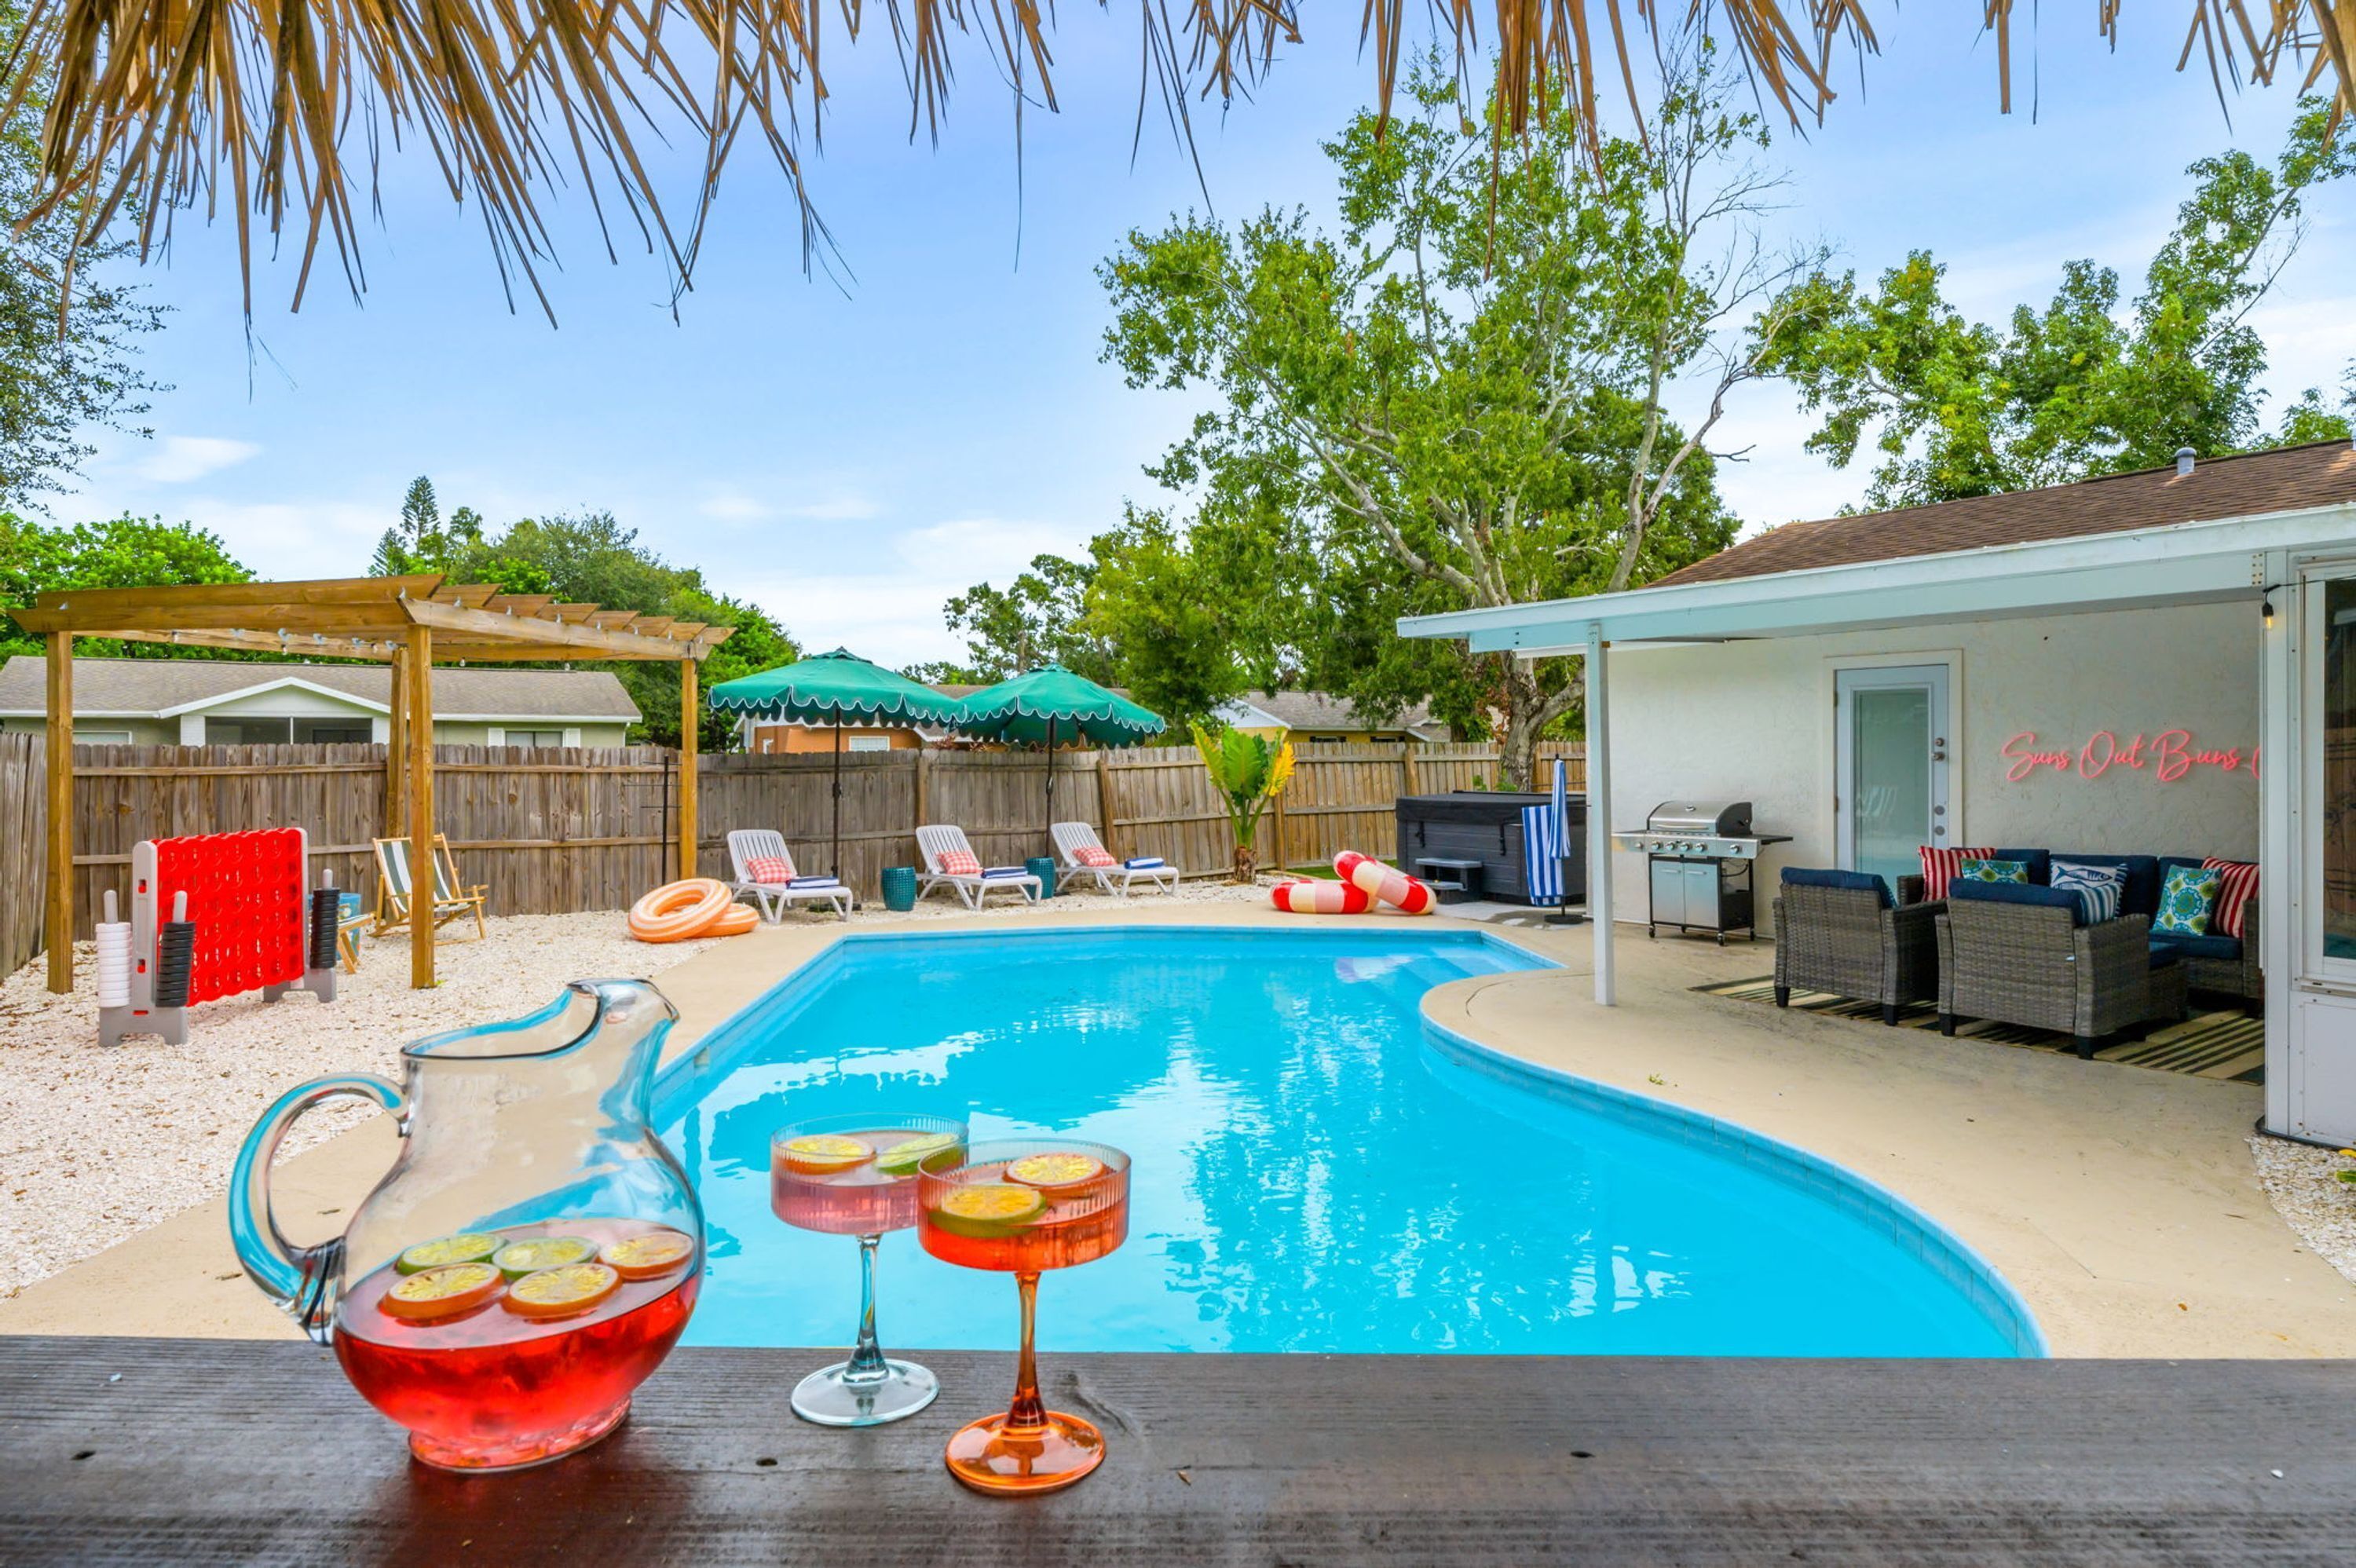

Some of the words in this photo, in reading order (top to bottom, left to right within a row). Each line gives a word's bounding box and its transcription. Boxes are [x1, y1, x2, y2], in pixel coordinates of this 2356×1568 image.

[2001, 731, 2070, 782] Suns
[2079, 730, 2146, 780] Out
[2150, 729, 2241, 782] Buns
